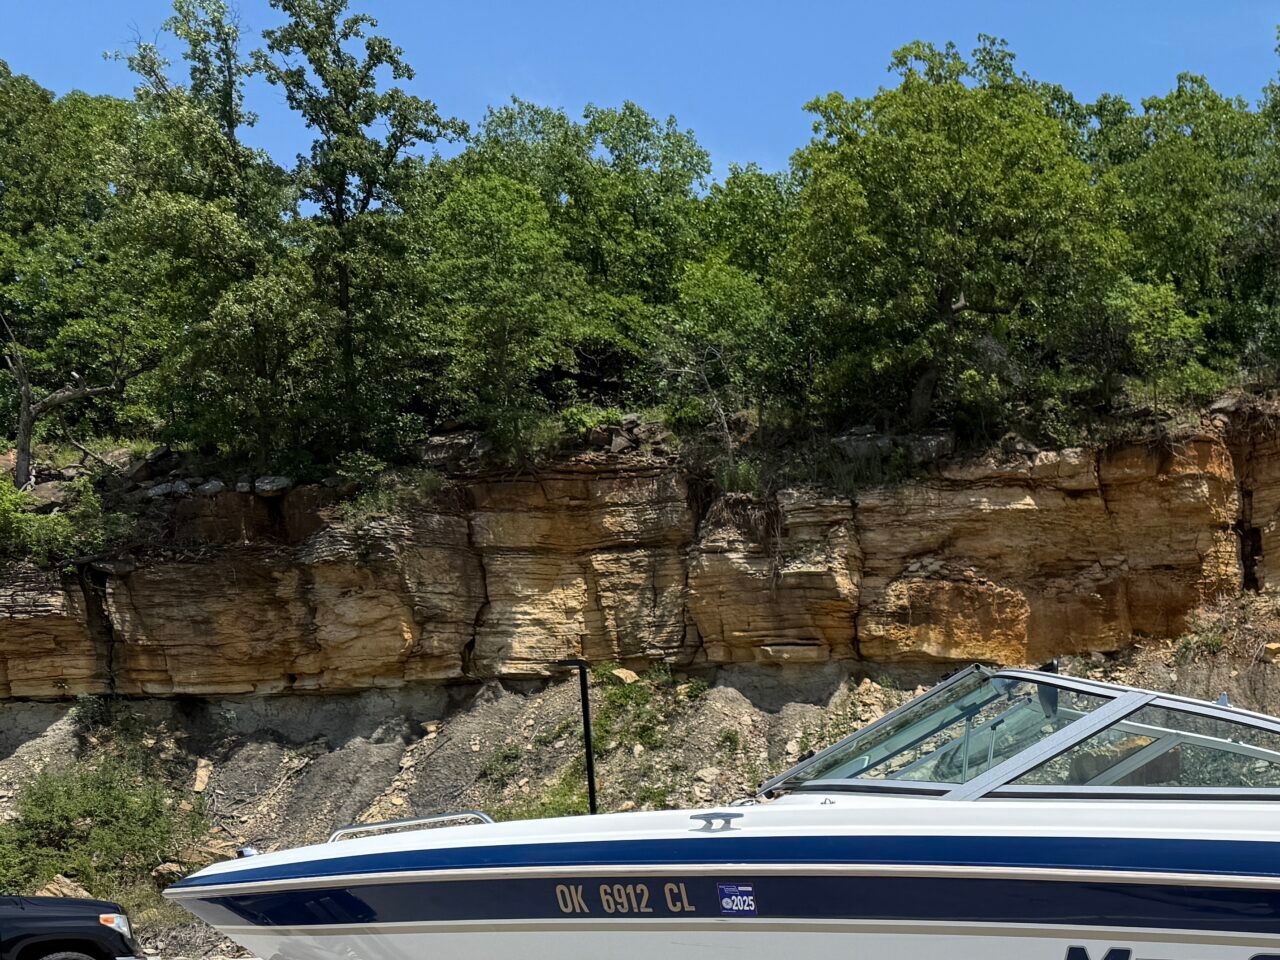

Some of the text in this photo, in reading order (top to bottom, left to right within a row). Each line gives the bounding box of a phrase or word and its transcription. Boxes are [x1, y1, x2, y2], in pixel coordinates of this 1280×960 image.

[555, 882, 696, 914] OK 6912 CL
[731, 895, 756, 911] 2025
